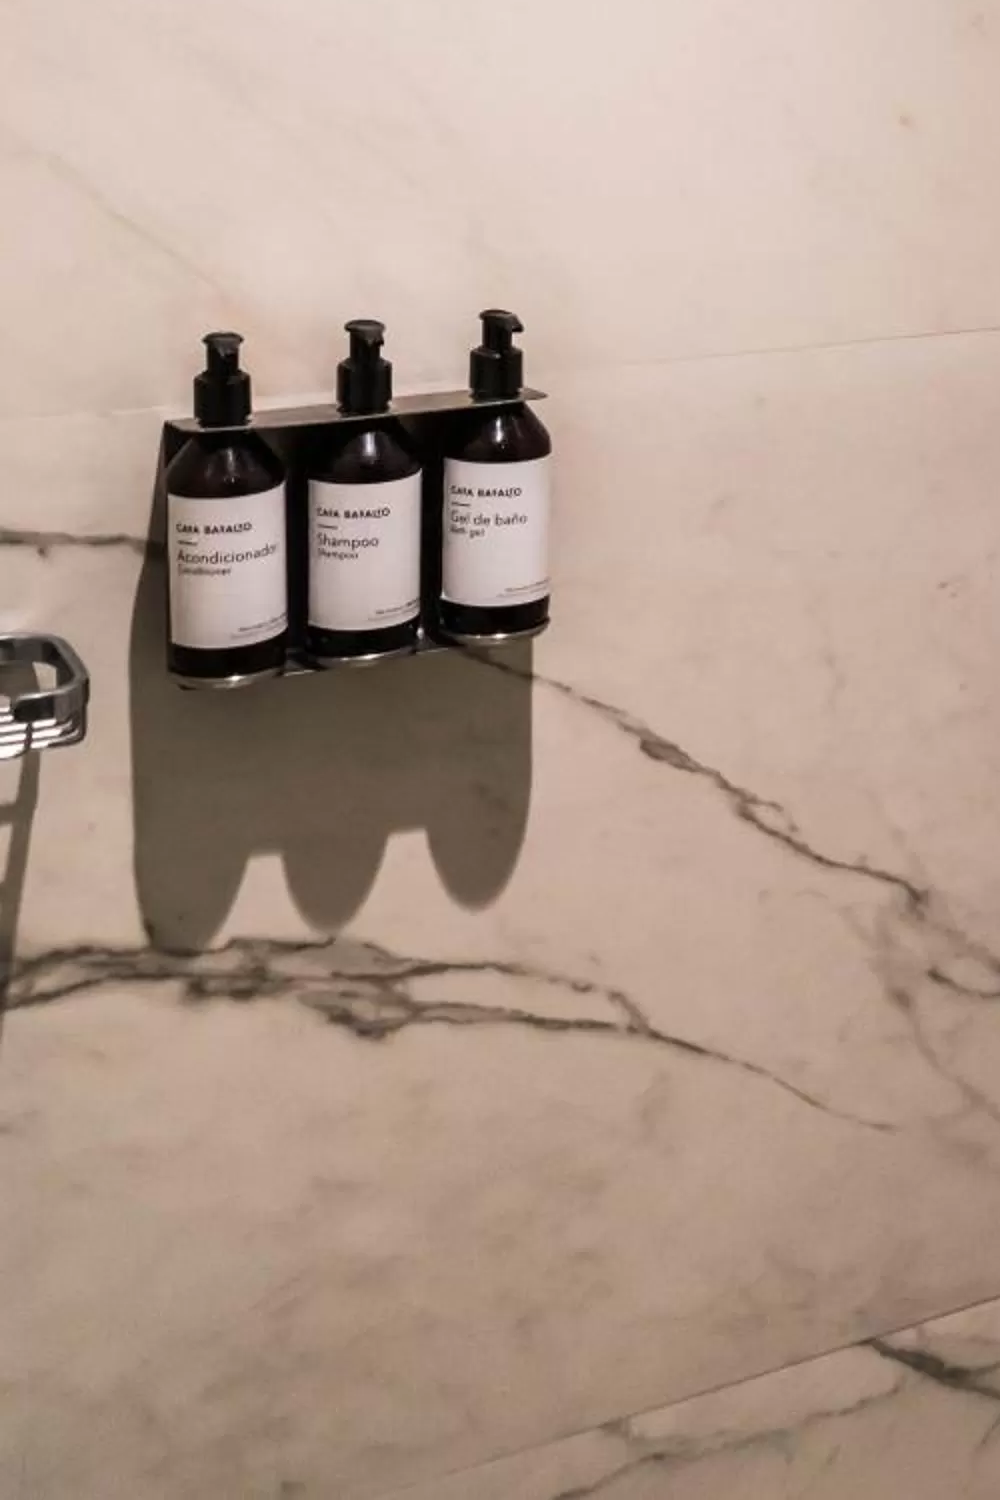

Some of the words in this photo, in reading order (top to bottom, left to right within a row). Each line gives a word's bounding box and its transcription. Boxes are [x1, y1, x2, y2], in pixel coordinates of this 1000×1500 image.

[450, 509, 470, 525] Gel
[473, 513, 491, 525] de
[317, 532, 379, 551] Shampoo
